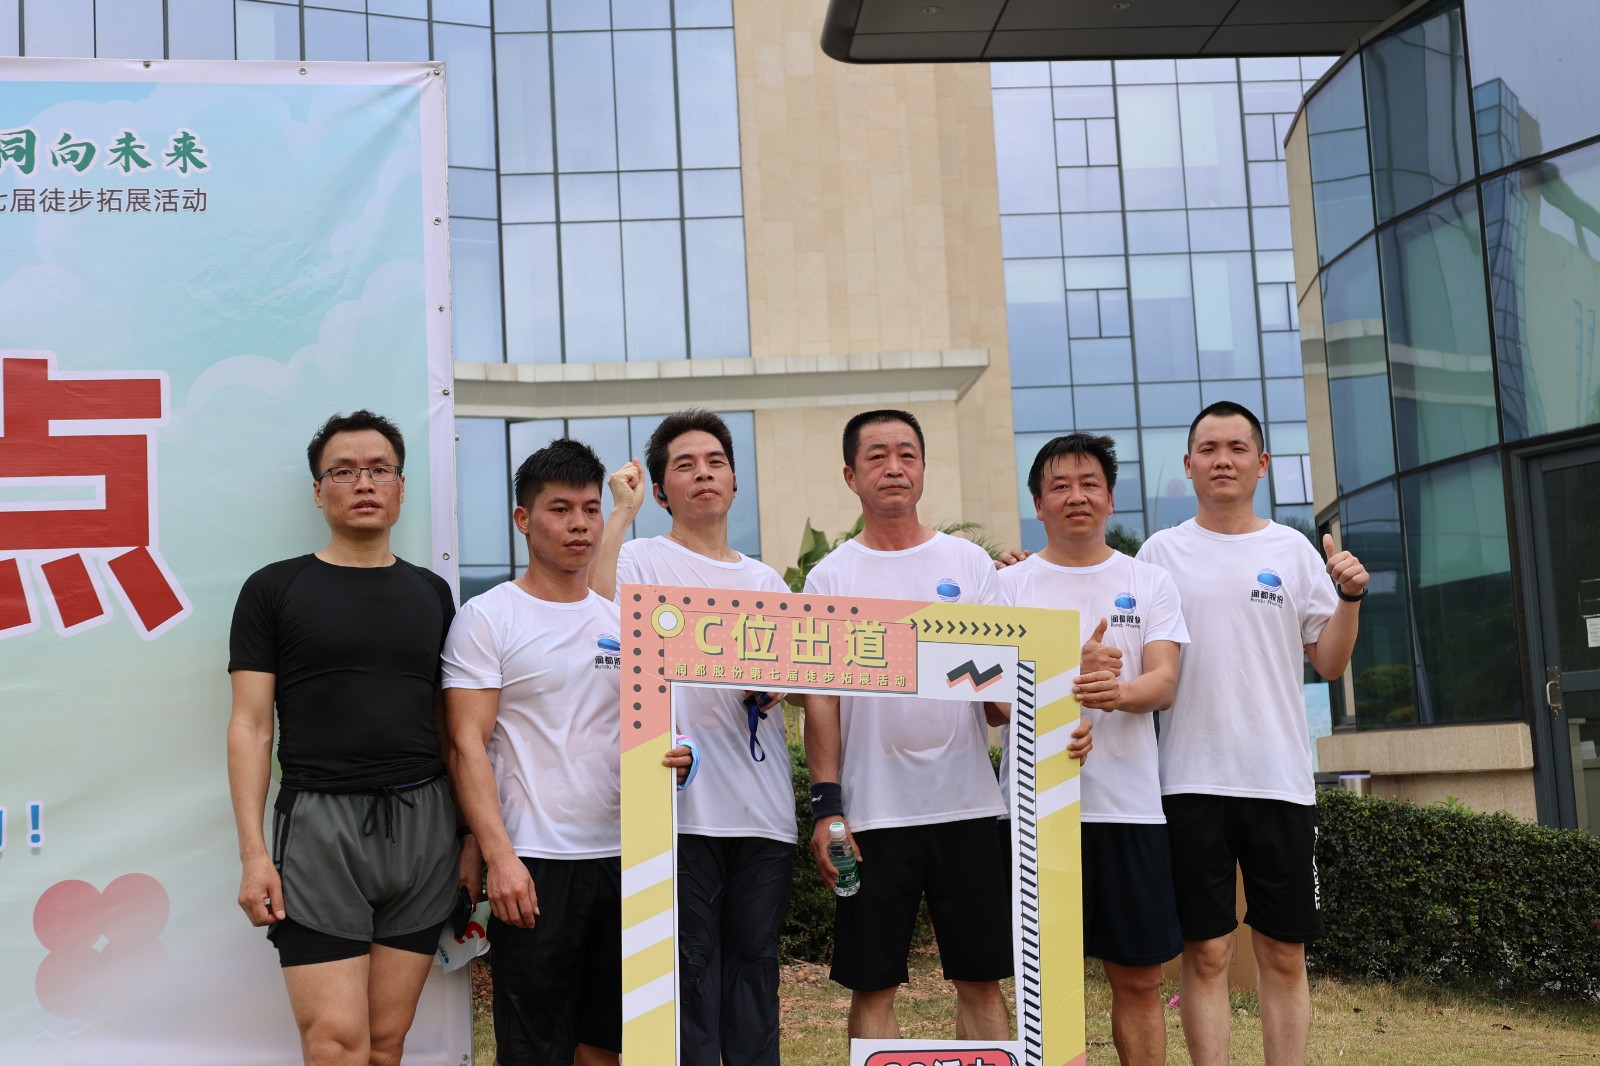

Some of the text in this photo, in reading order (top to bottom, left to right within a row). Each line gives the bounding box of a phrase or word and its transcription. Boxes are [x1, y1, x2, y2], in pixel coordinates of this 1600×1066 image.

[694, 611, 888, 669] C位出道
[674, 662, 907, 688] 润都股份第七届徒步拓展活动
